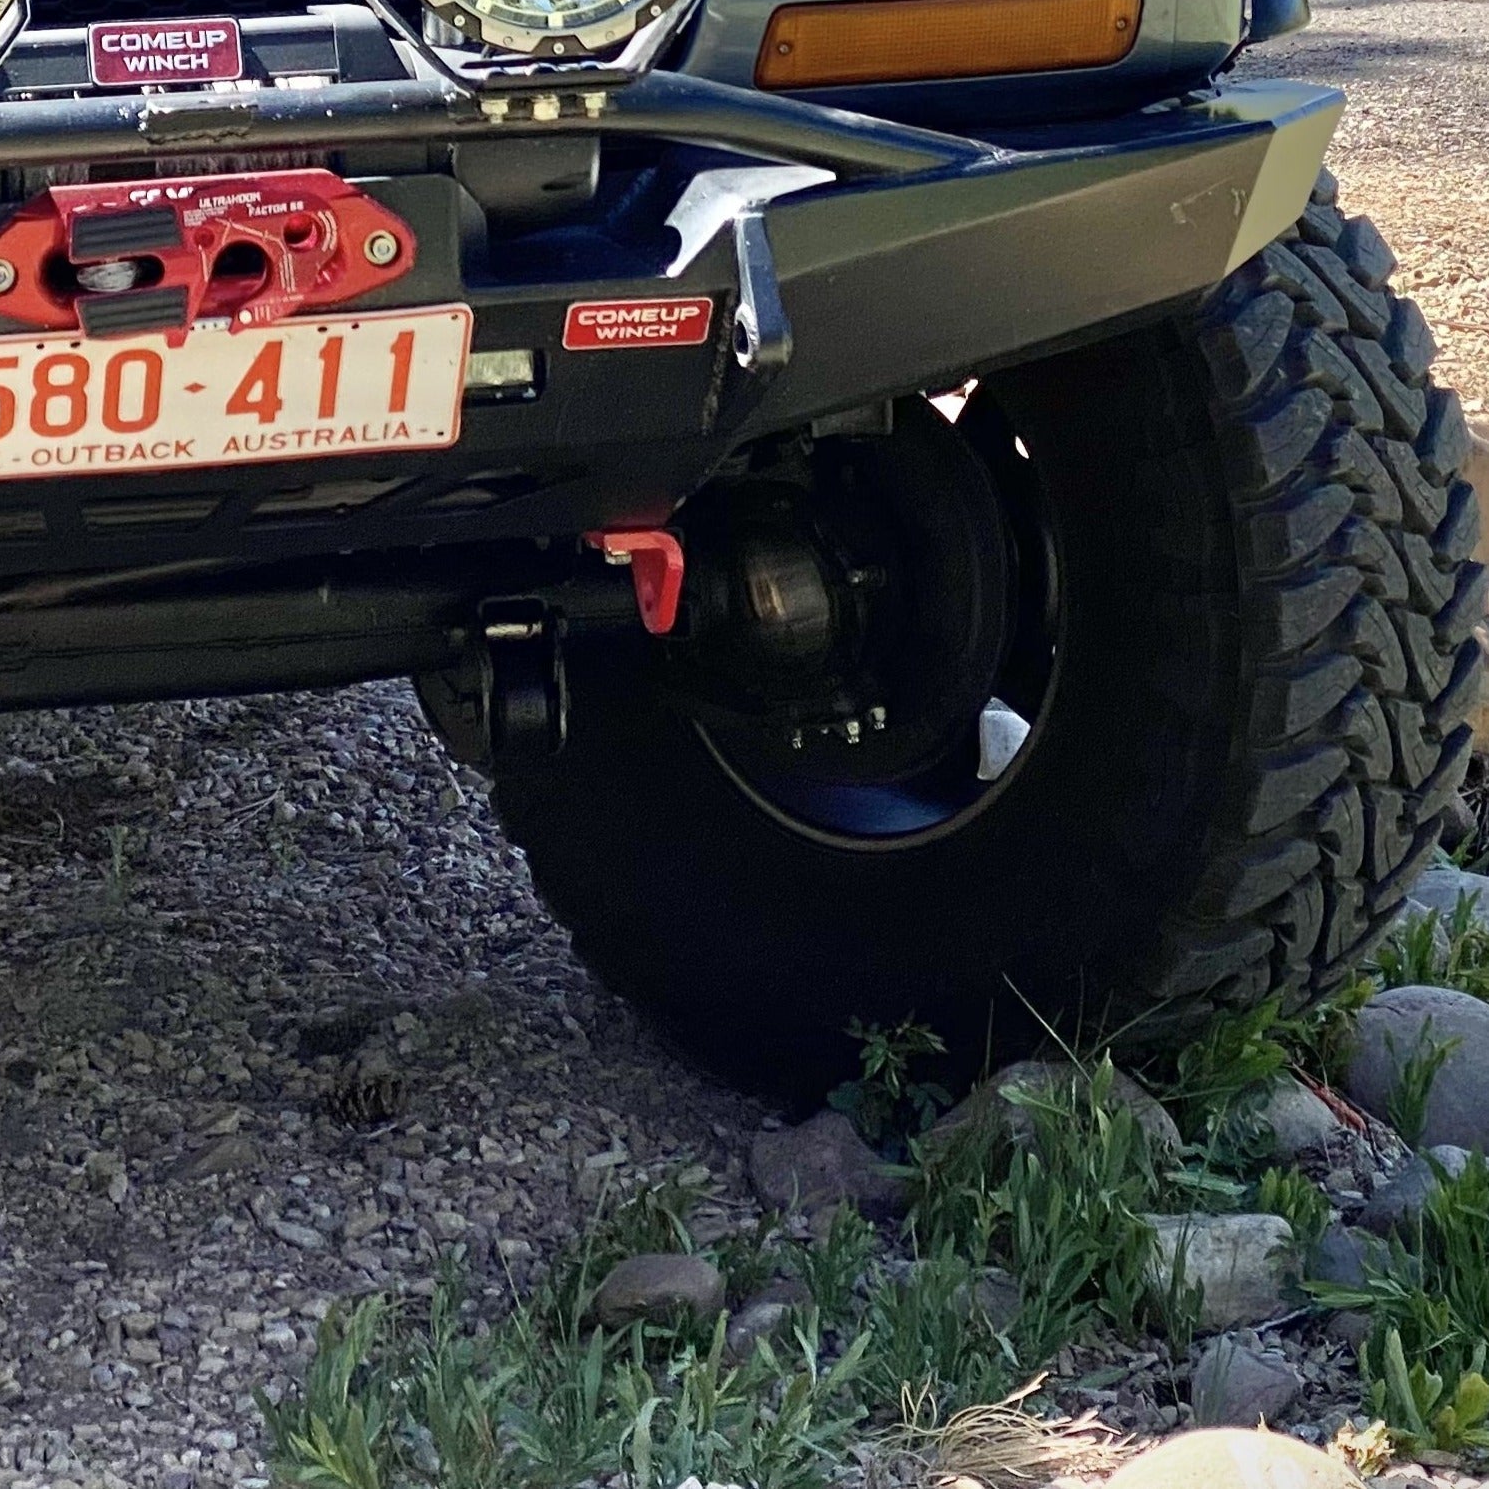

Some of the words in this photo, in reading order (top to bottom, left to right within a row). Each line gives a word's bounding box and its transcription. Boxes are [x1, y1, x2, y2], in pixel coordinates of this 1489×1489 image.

[101, 30, 228, 52] COMEUP
[123, 53, 209, 72] WINCH
[578, 306, 701, 325] COMEUP
[596, 324, 677, 340] WINCH
[30, 439, 196, 467] OUTBACK
[222, 421, 411, 453] AUSTRALIA
